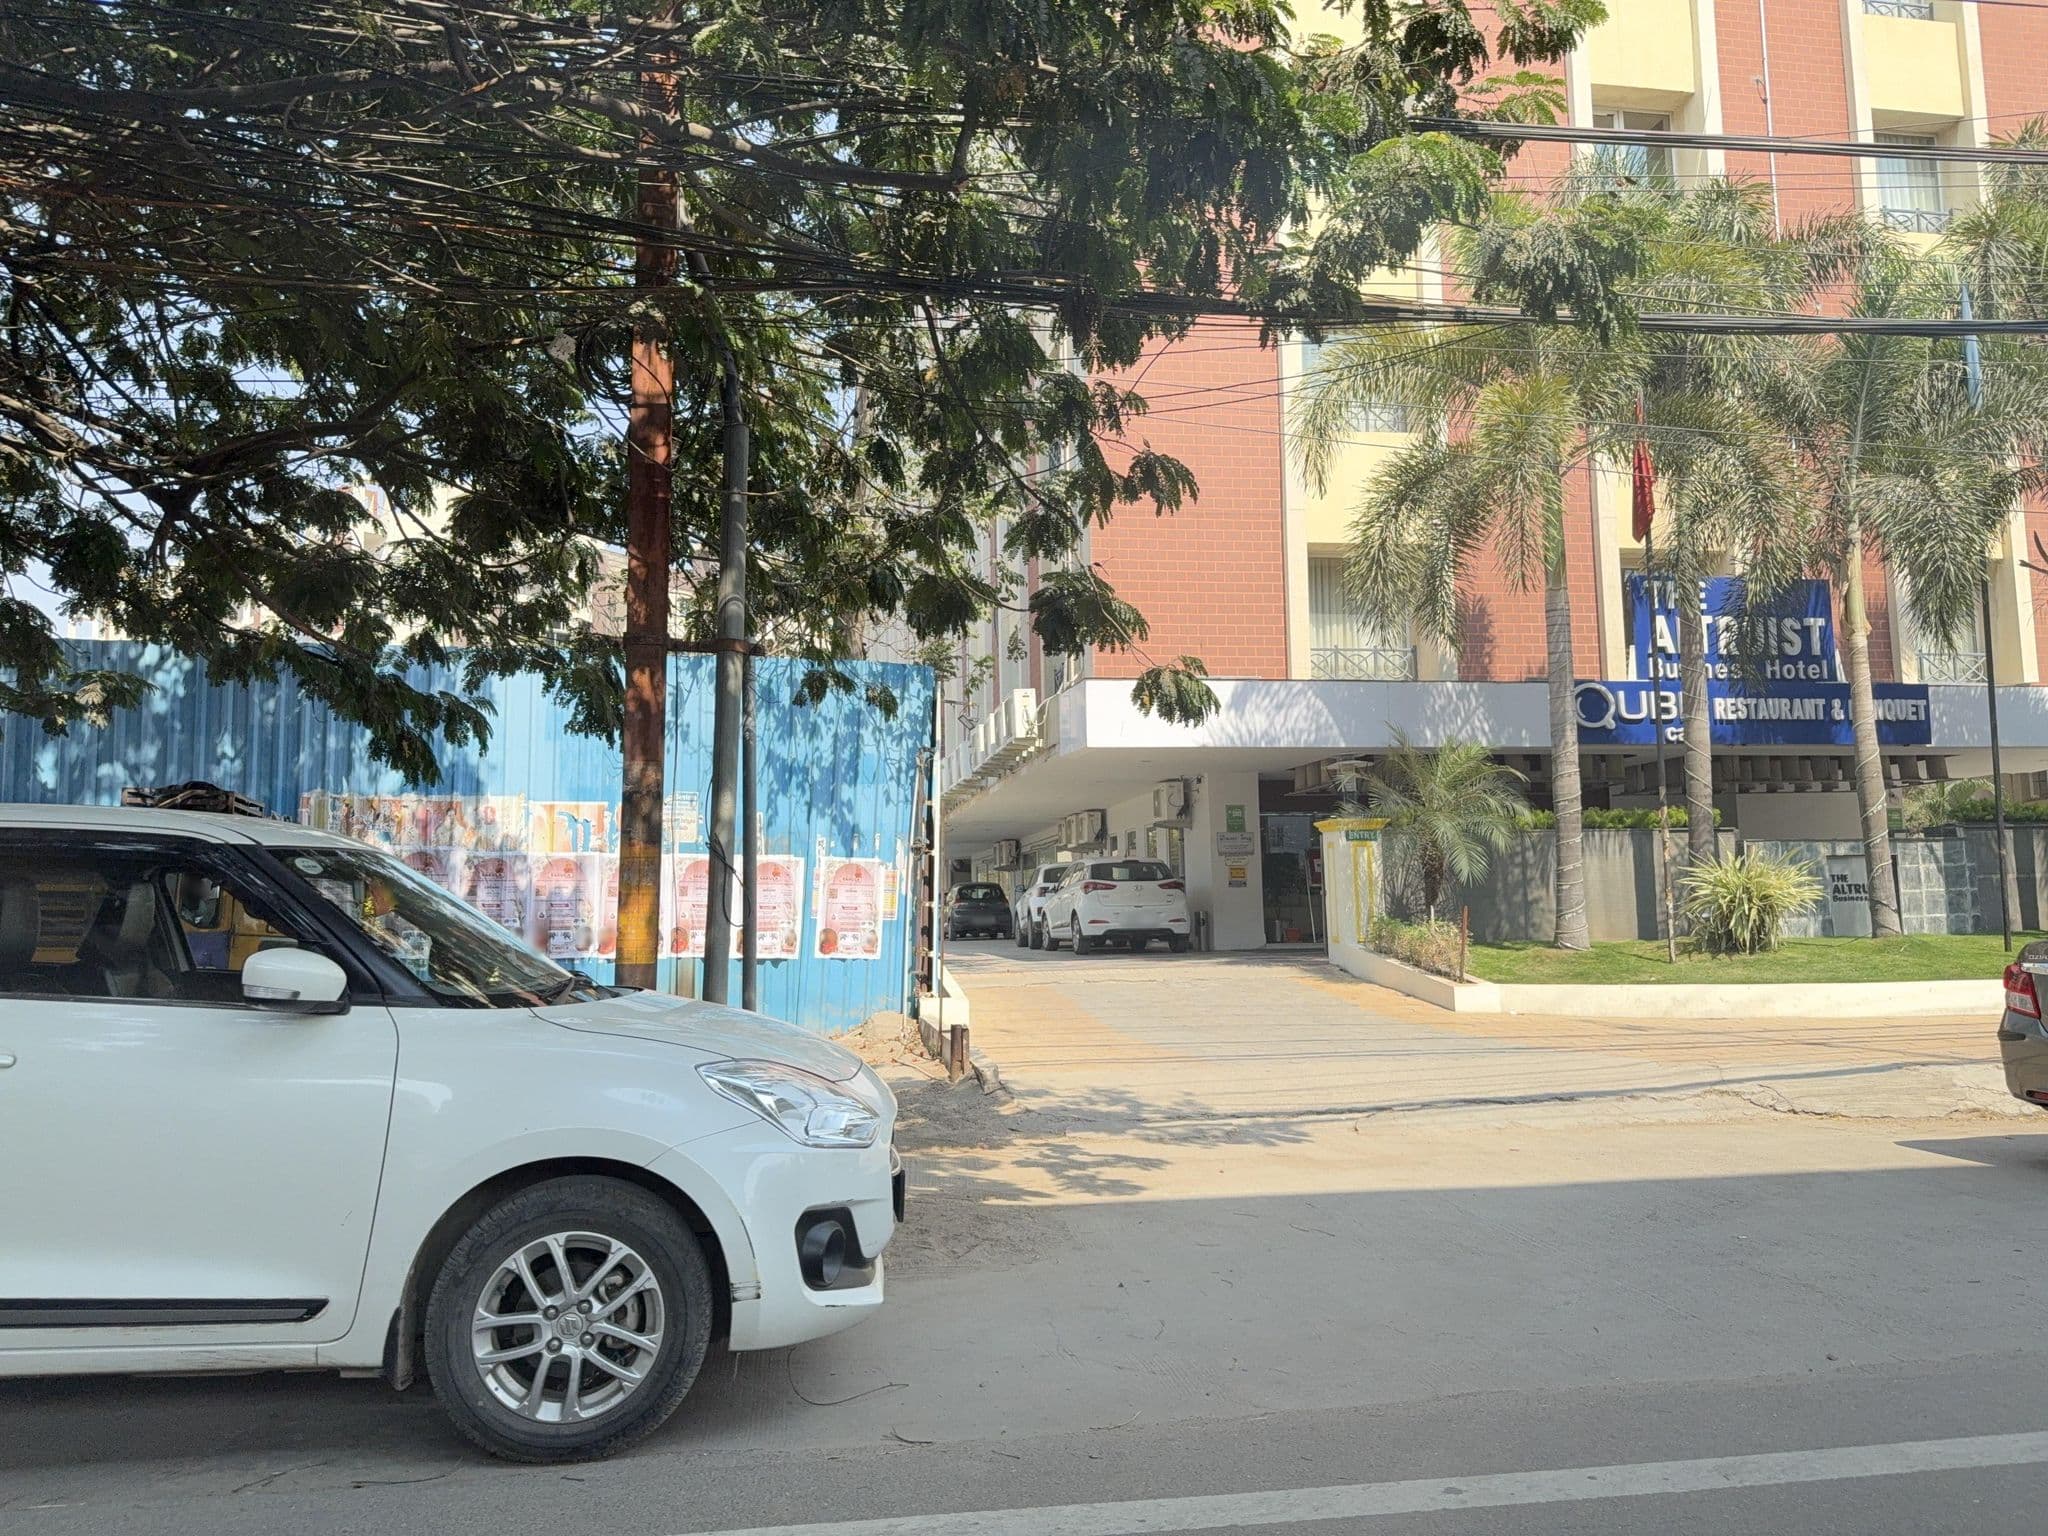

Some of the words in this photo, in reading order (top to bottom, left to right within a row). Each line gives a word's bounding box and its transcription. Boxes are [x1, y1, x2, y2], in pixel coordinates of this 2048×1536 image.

[1765, 659, 1829, 681] Hotel
[1574, 682, 1684, 730] QUB
[1713, 697, 1826, 721] RESTAURANT
[1831, 697, 1845, 721] &
[1830, 873, 1849, 883] THE
